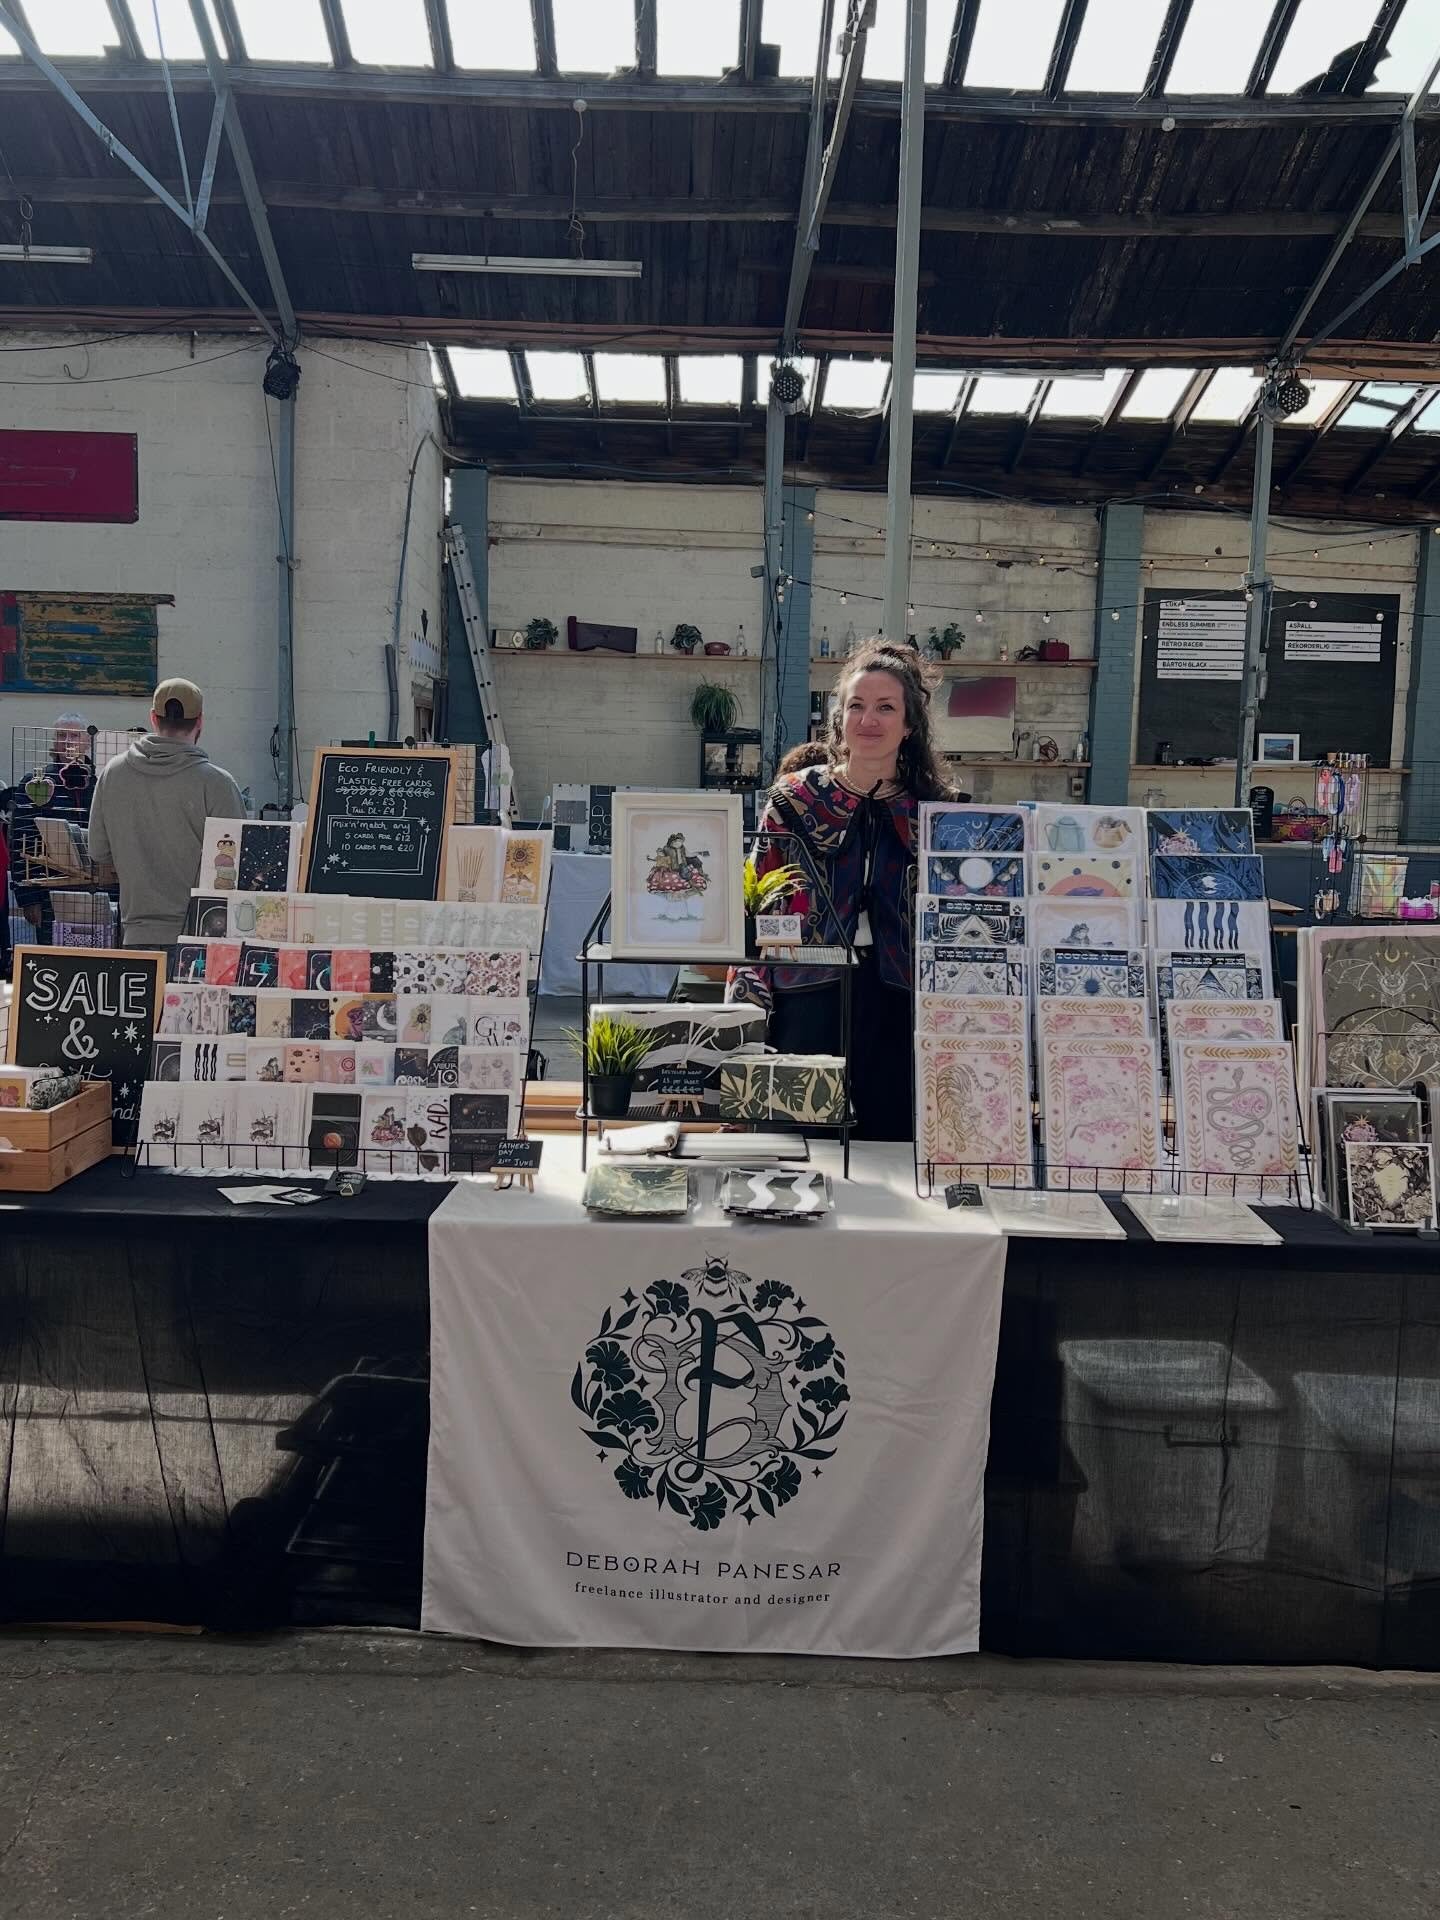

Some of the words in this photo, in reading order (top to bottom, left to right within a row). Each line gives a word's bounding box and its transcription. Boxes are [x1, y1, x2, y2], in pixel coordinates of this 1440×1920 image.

[1189, 621, 1216, 629] SUMMER
[1161, 640, 1182, 648] RETRO
[1183, 641, 1204, 649] RACER
[1162, 661, 1187, 669] BARTON
[365, 762, 412, 775] FRIENDLY
[337, 775, 378, 786] PLASTIC
[381, 778, 402, 787] FREE
[404, 779, 433, 788] CARDS
[392, 823, 411, 835] any
[344, 832, 351, 840] 5
[395, 832, 411, 842] £12
[341, 843, 351, 851] 10
[397, 843, 415, 852] £20
[1056, 952, 1099, 960] TOUCH
[26, 968, 148, 1019] SALE
[61, 1017, 100, 1060] &
[498, 1142, 531, 1150] FATHER'S
[514, 1159, 534, 1167] JUNE
[566, 1551, 700, 1576] DEBORAH
[717, 1561, 842, 1580] PANESAR
[574, 1581, 643, 1599] freelance
[649, 1588, 729, 1604] illustrator
[734, 1593, 761, 1606] and
[767, 1591, 831, 1606] designer
